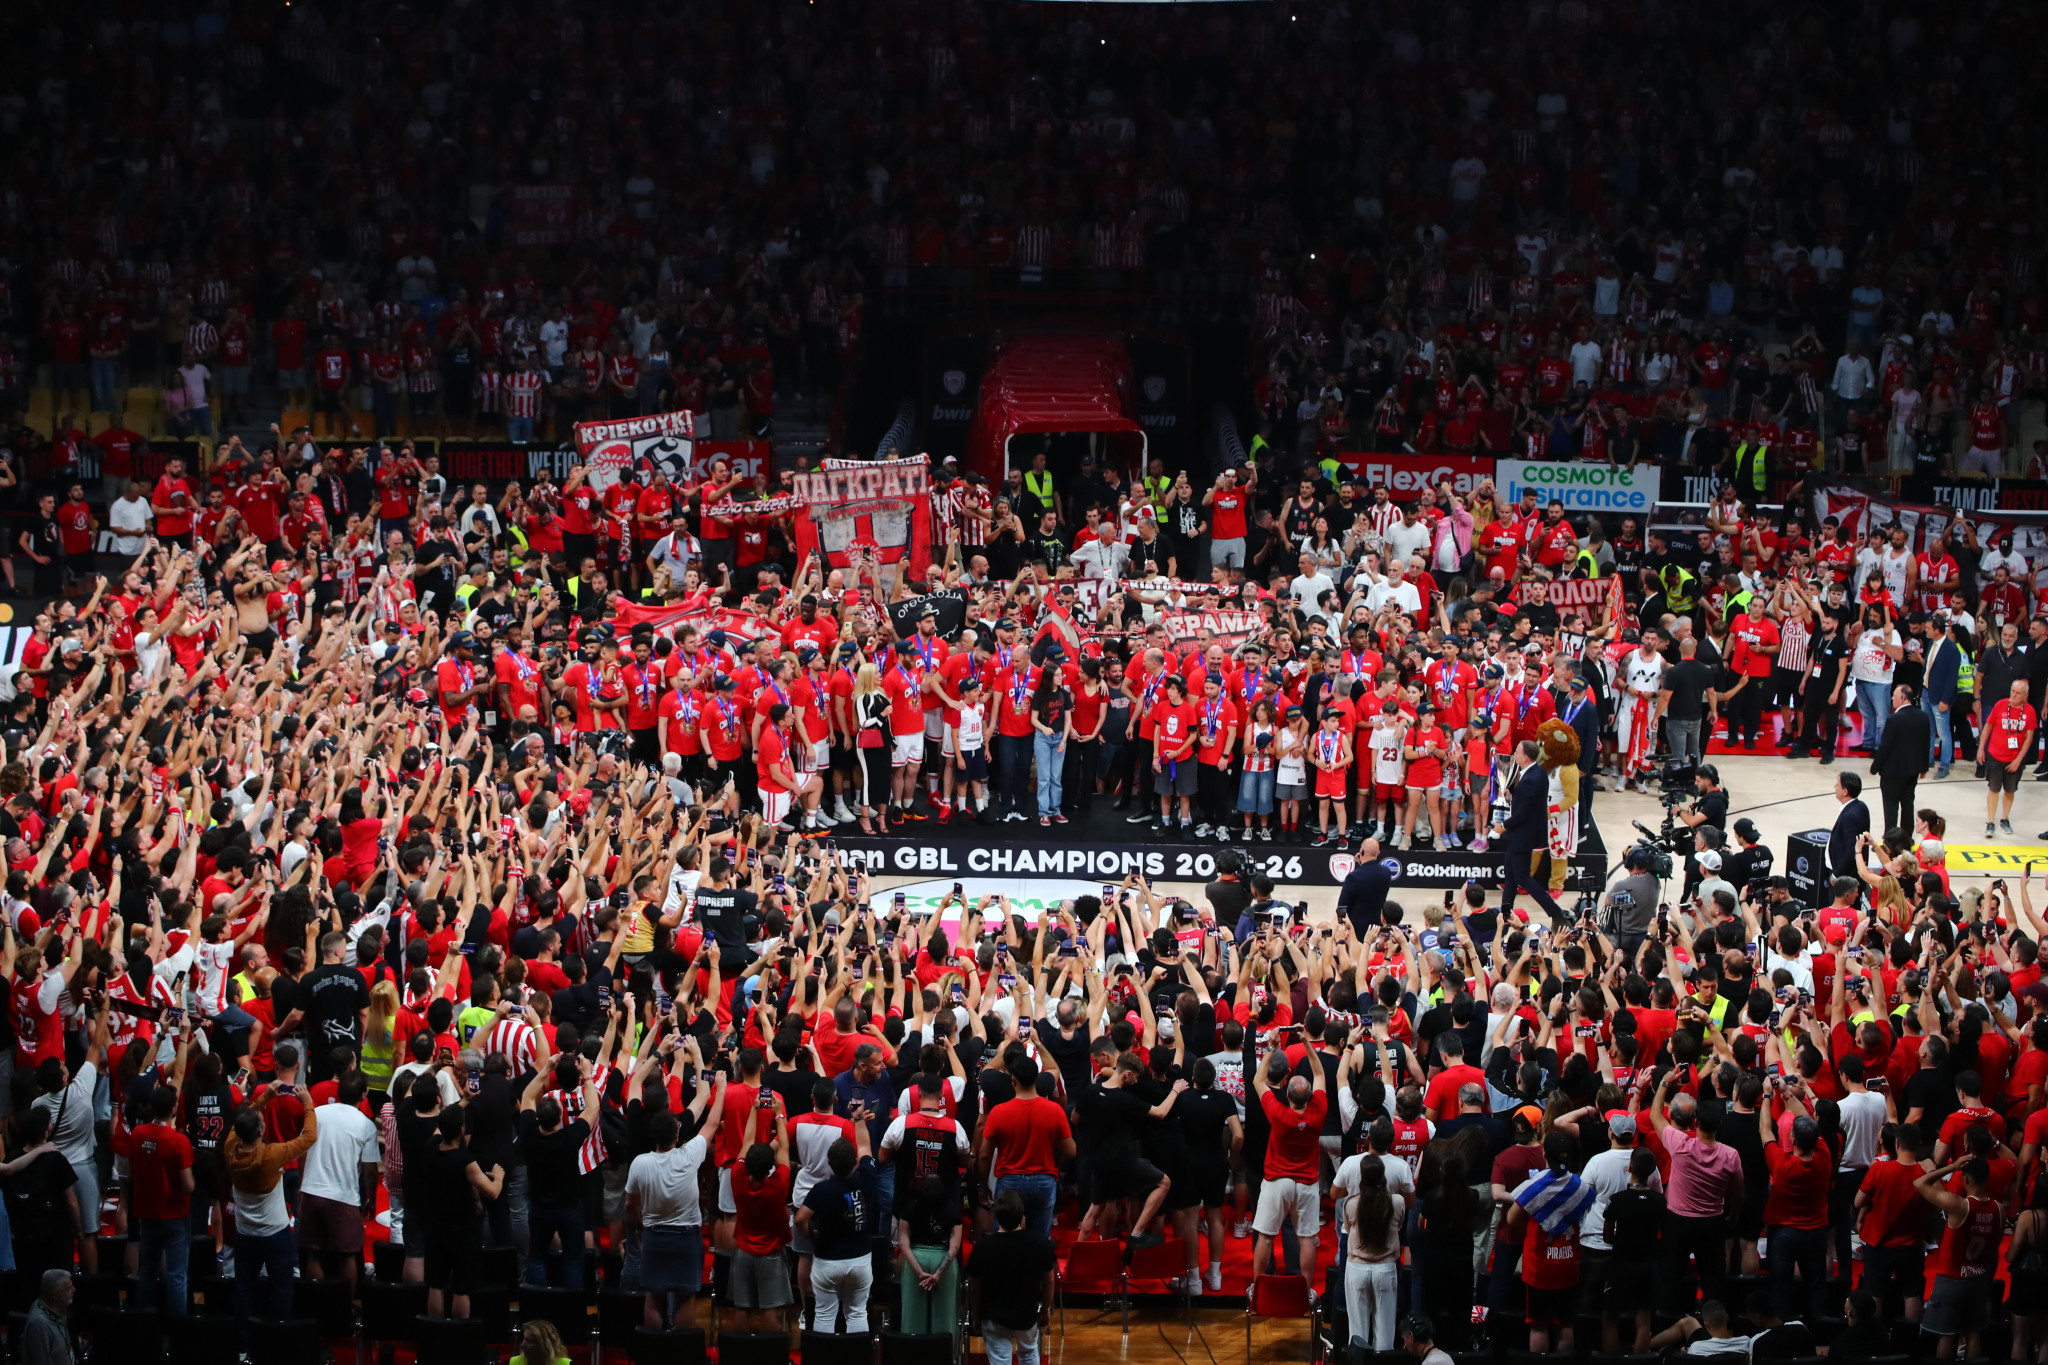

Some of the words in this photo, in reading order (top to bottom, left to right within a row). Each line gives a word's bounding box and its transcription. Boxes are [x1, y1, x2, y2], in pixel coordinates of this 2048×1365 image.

[580, 410, 693, 444] ΚΡΙΕΚΟΥΚΙ
[446, 451, 525, 479] TOGETHER
[528, 451, 551, 479] WE
[697, 452, 763, 478] xCar
[793, 466, 928, 504] ΠΑΓΚΡΑΤΙ
[1523, 466, 1634, 487] COSMOTE
[1933, 485, 1976, 511] TEAM
[1979, 487, 1999, 510] OF
[1671, 540, 1693, 551] CREW
[971, 722, 980, 733] 88
[1383, 747, 1398, 761] 23
[894, 847, 958, 871] GBL
[967, 848, 1164, 876] CHAMPIONS
[1175, 853, 1303, 878] 20-26
[1406, 862, 1492, 878] Stoiximan
[1795, 880, 1808, 890] GBL
[697, 896, 735, 908] SUPREME
[1401, 1131, 1416, 1140] JONES
[915, 1149, 940, 1178] 15
[1546, 1246, 1574, 1261] PIRAEUS
